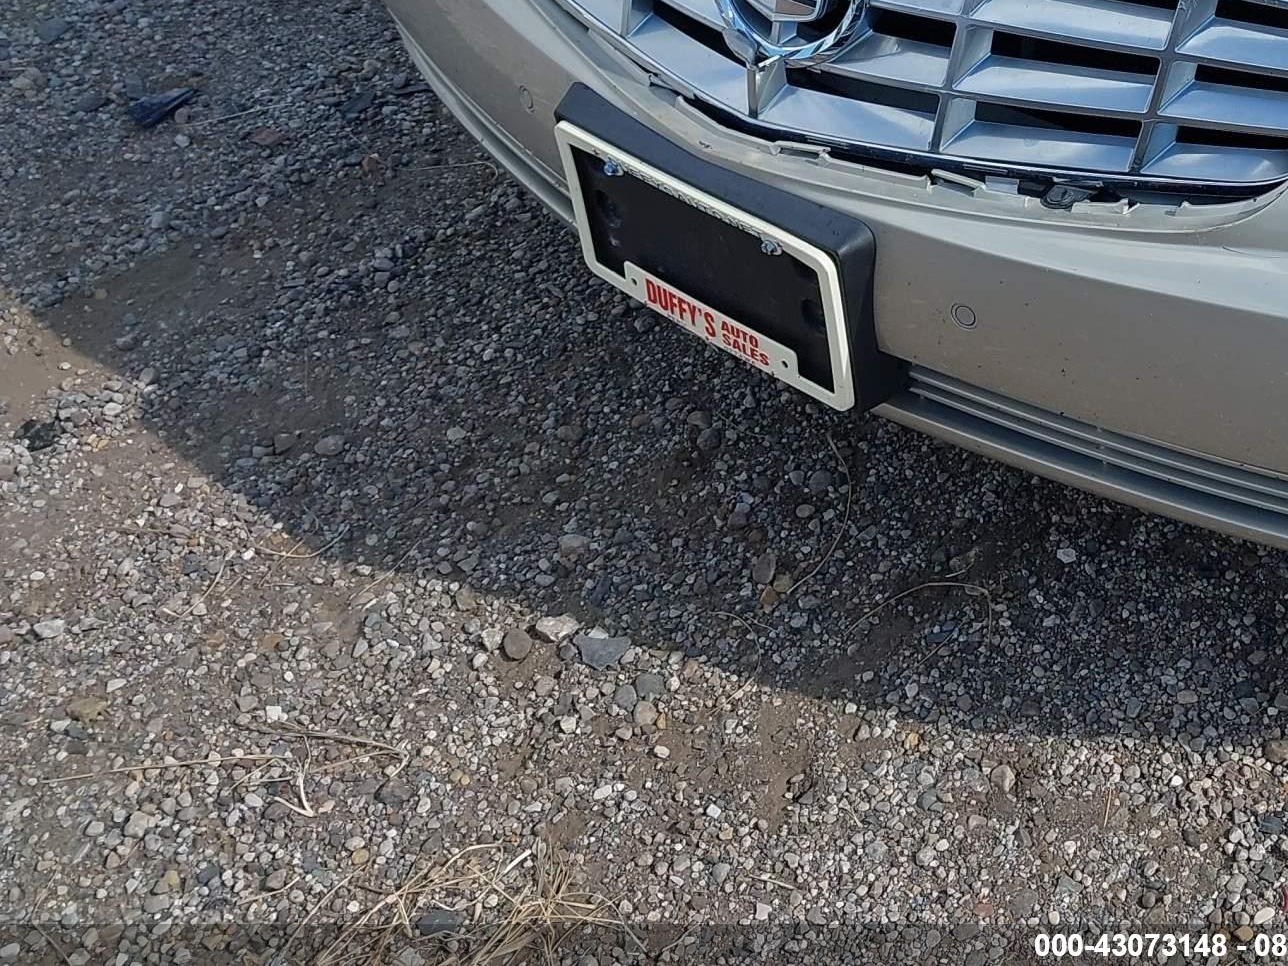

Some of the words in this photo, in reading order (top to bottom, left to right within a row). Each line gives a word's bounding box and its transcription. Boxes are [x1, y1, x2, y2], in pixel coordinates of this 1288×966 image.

[645, 277, 717, 338] DUFFY'S
[720, 320, 759, 349] AUTO
[722, 333, 770, 366] SALES
